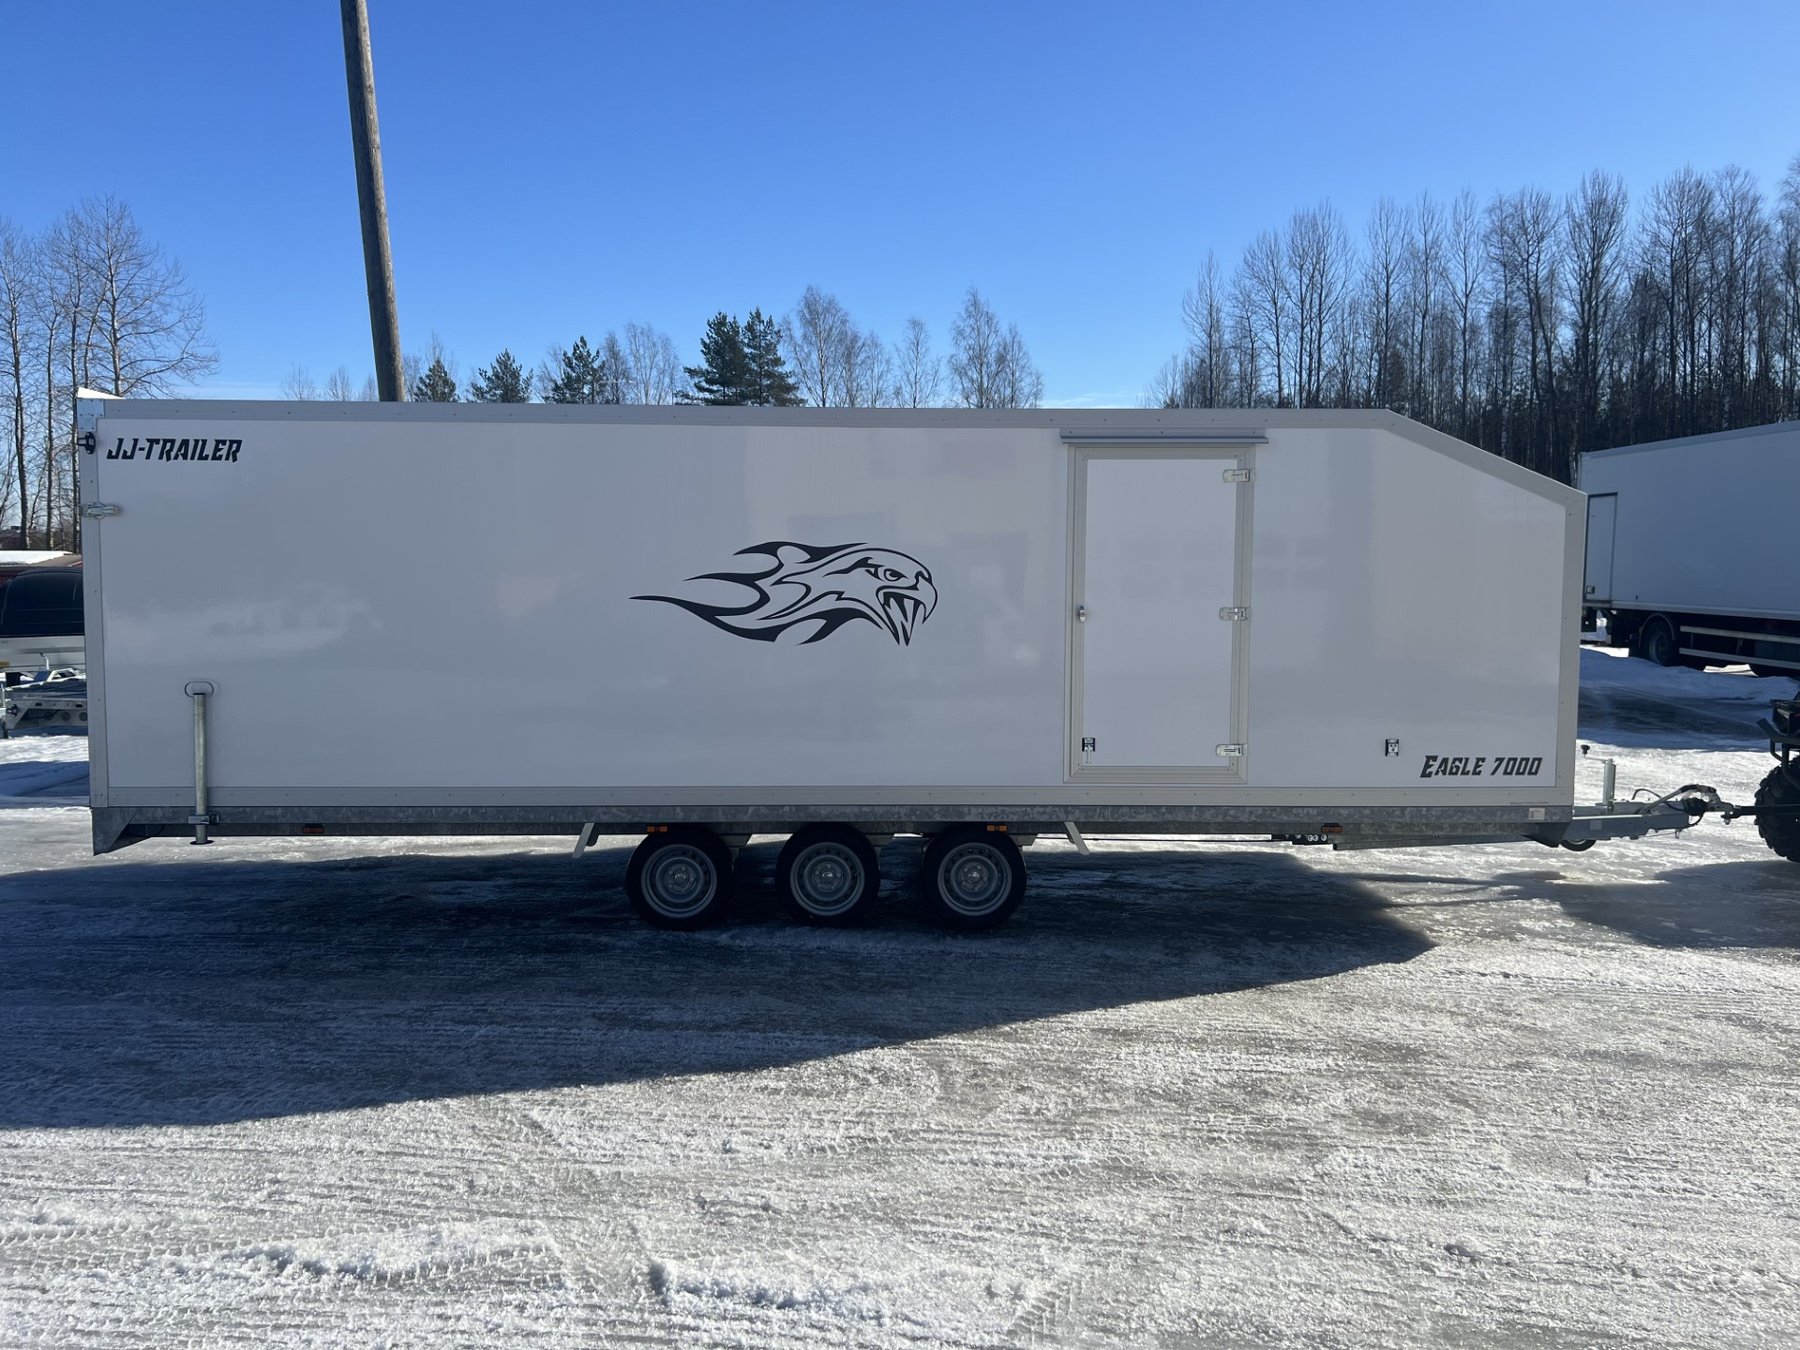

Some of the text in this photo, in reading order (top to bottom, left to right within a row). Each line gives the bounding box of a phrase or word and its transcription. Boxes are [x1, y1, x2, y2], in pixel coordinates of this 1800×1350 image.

[106, 438, 243, 463] JJ-TRAILER
[1420, 755, 1543, 778] EAGLE 7000
